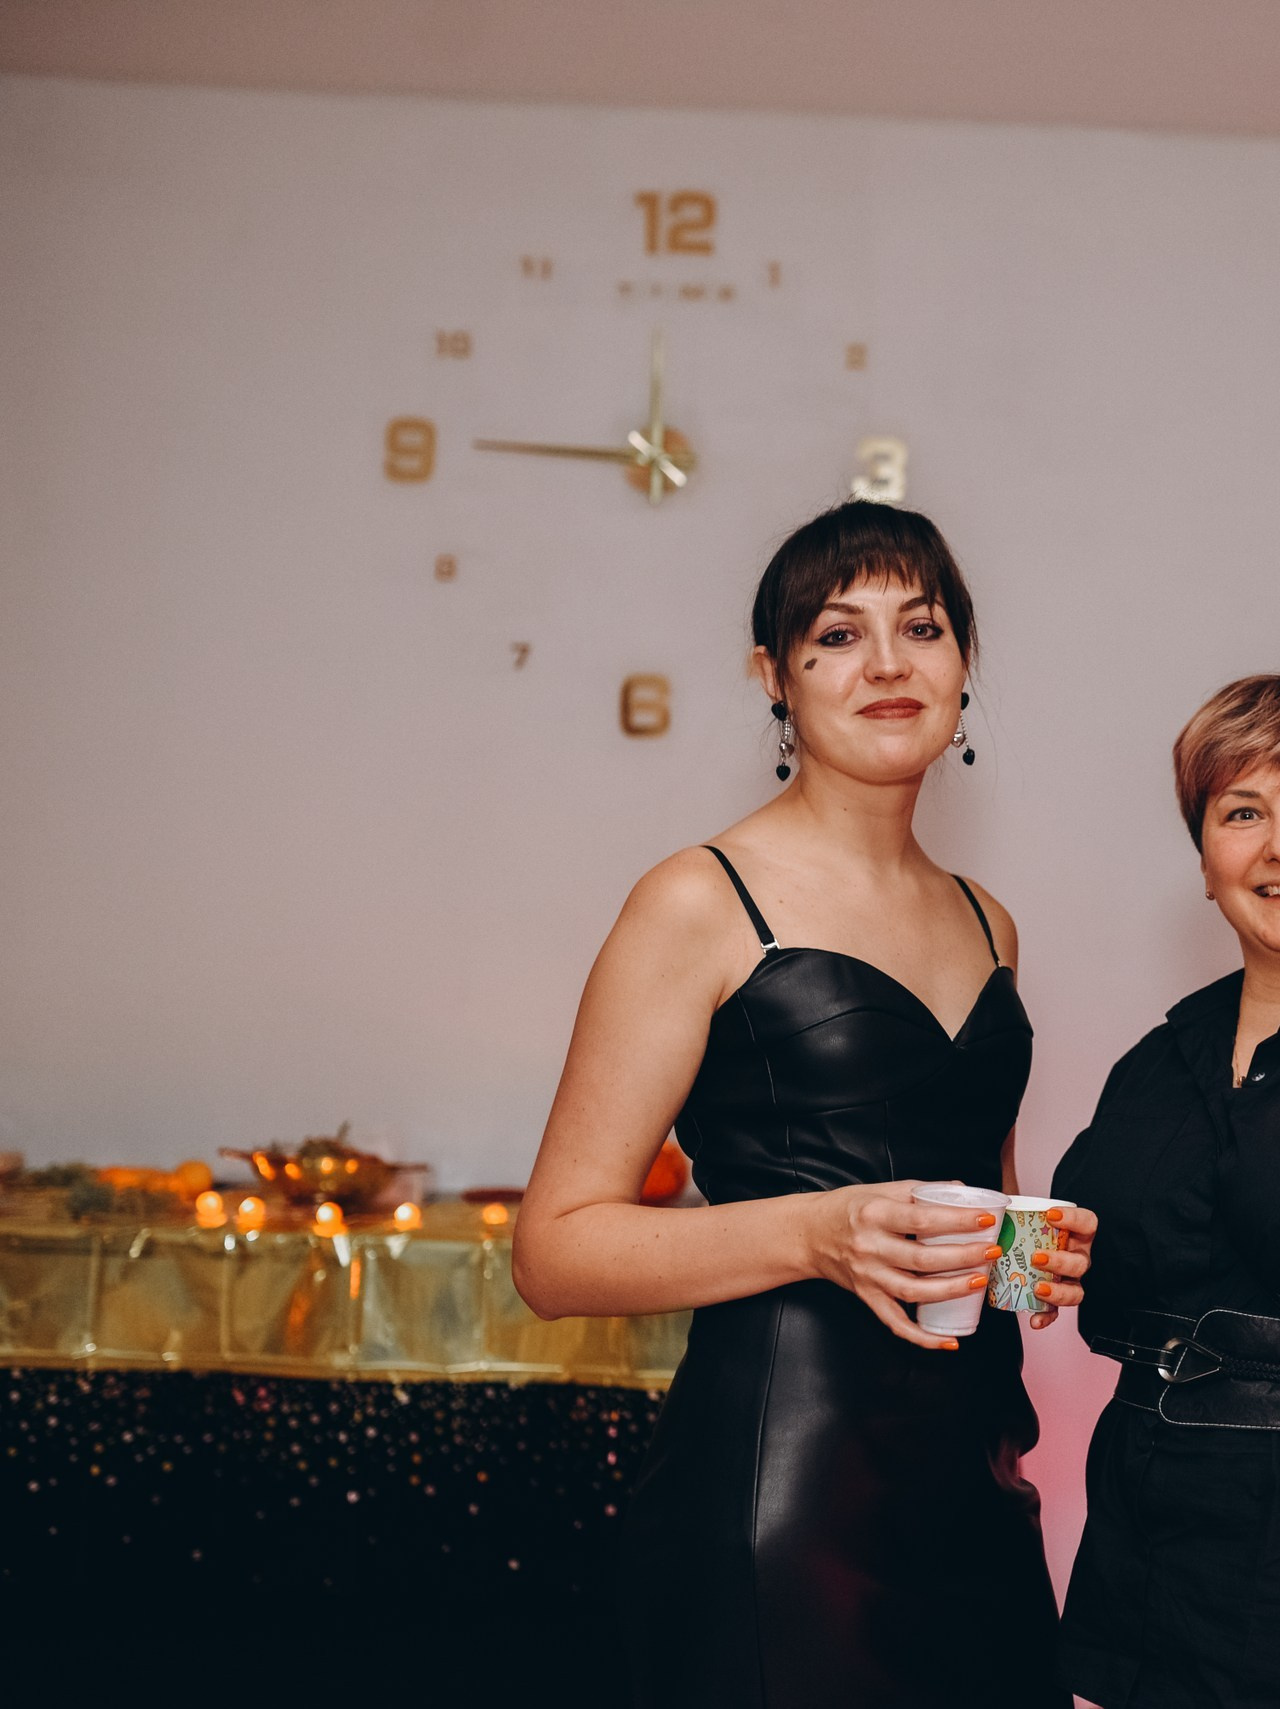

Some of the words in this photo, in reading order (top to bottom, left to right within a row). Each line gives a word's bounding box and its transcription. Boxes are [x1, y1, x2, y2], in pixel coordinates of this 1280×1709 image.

[634, 189, 718, 257] 12
[434, 329, 474, 360] 10
[383, 415, 438, 485] 9
[852, 436, 906, 502] 3
[511, 641, 532, 671] 7
[618, 674, 671, 740] 6
